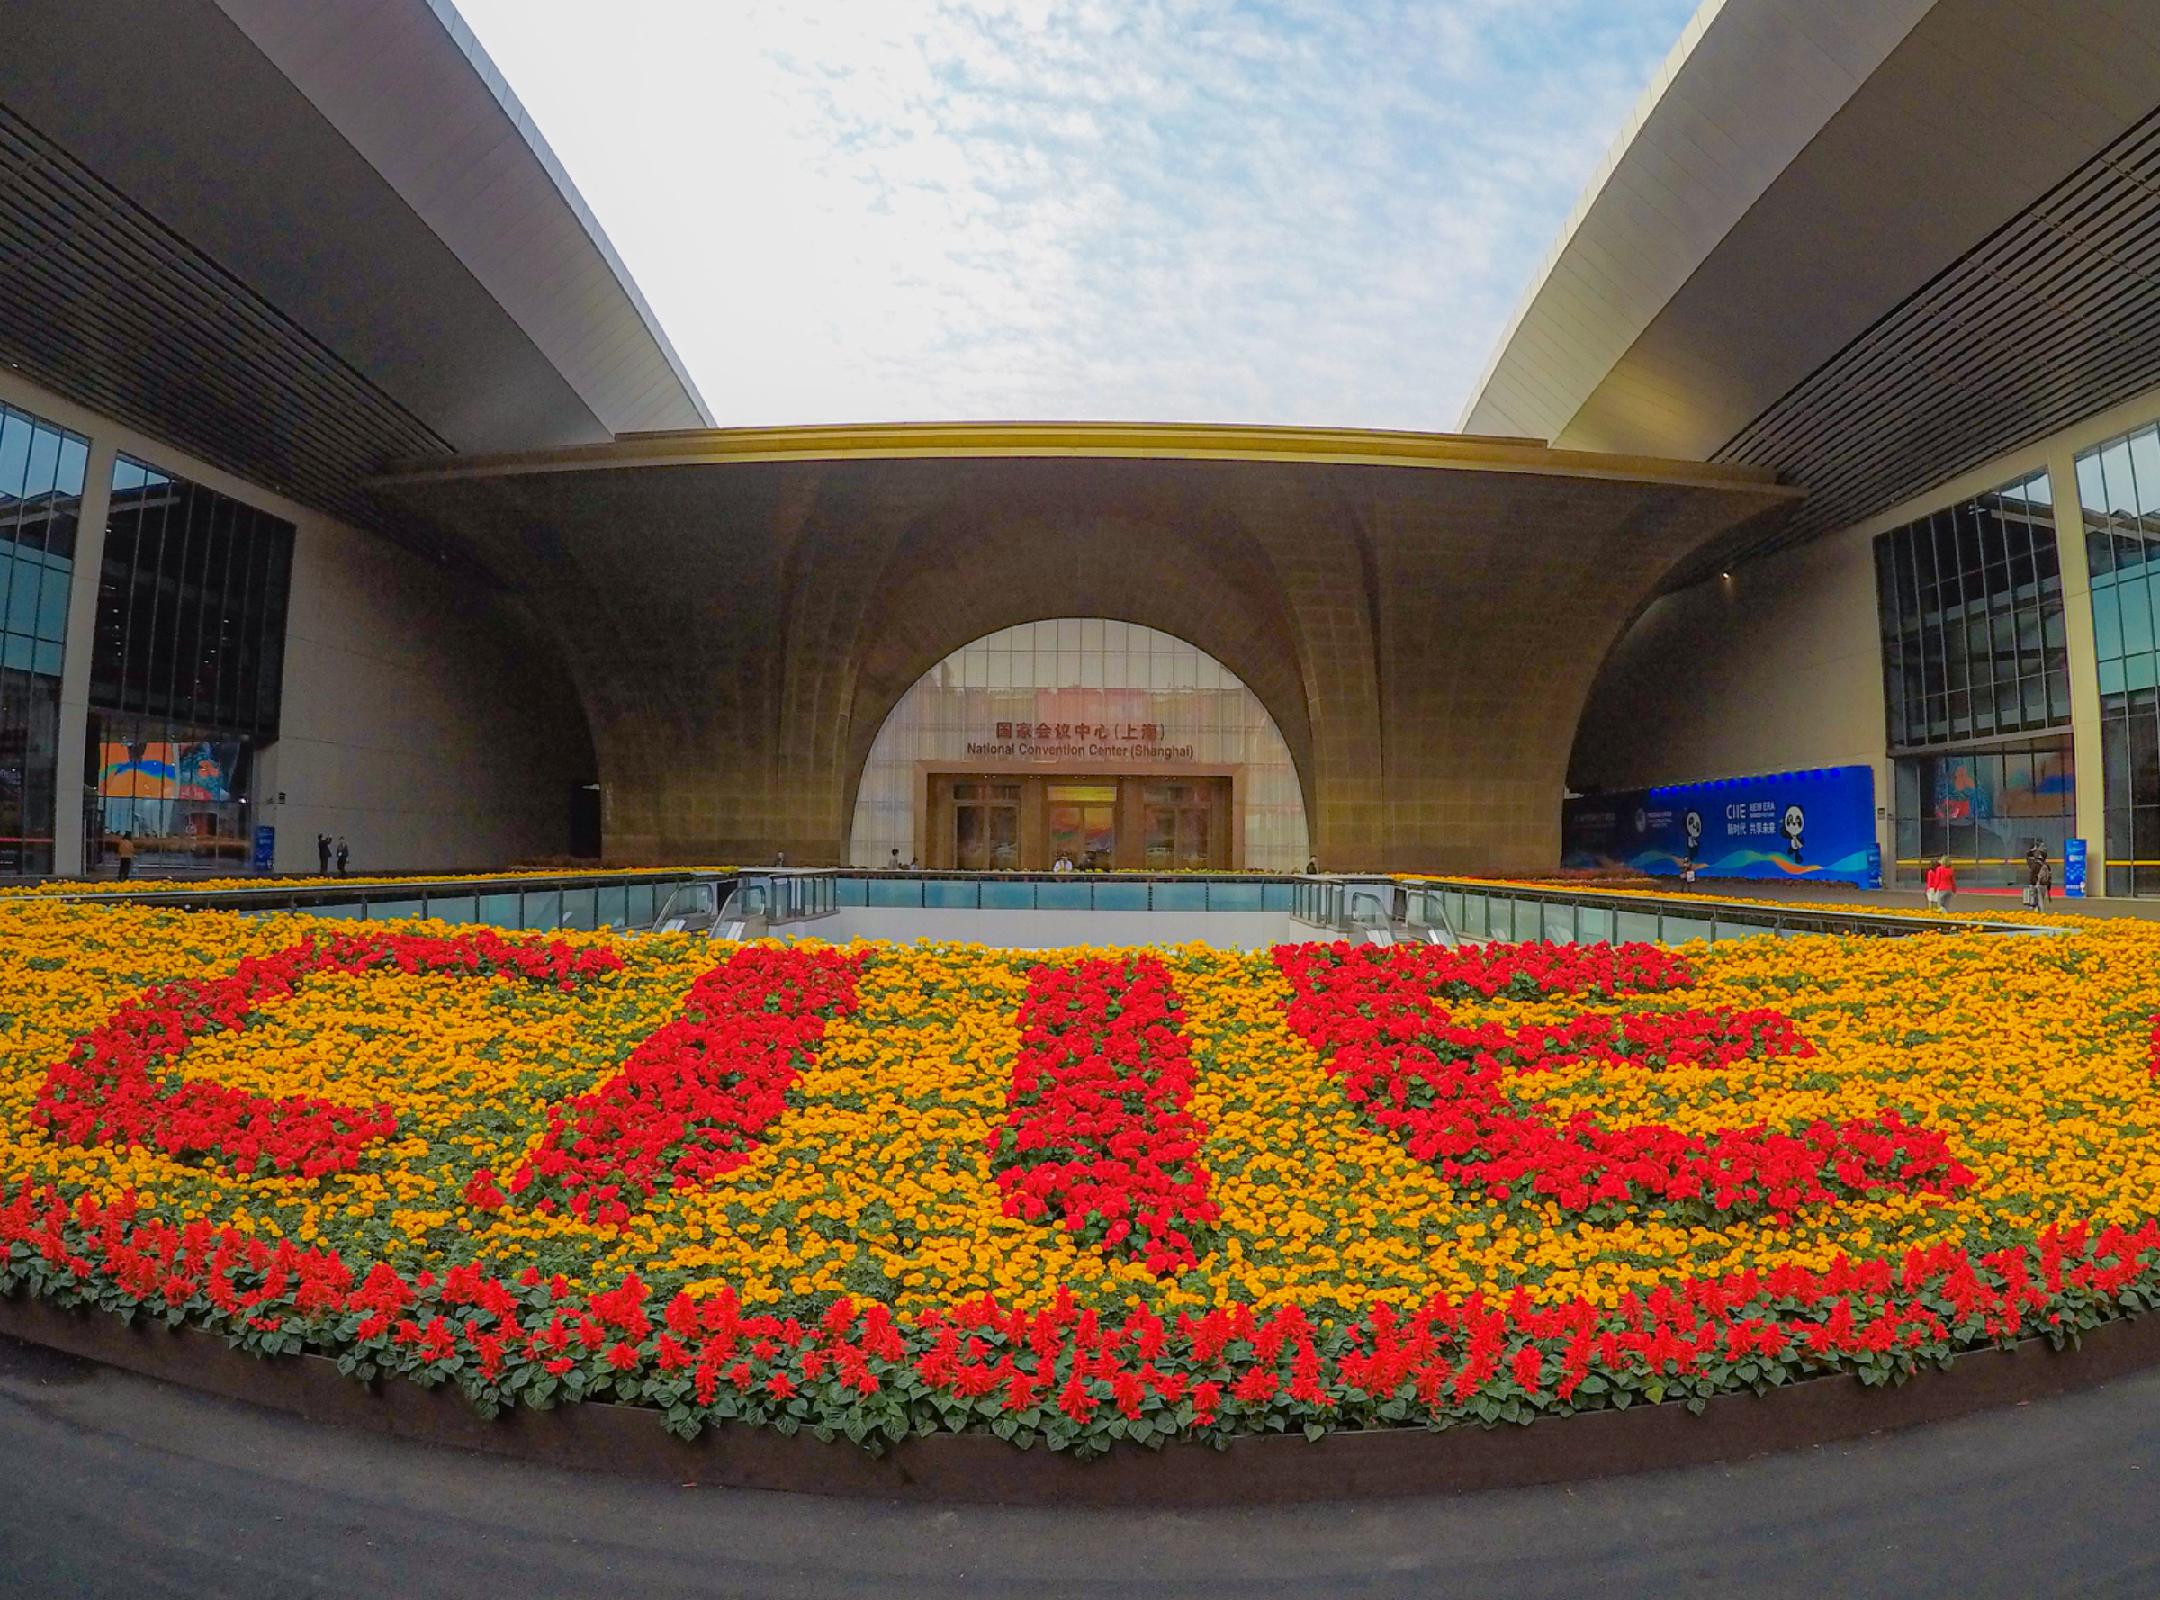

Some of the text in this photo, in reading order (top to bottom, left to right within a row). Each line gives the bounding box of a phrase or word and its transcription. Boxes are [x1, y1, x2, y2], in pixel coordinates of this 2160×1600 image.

[966, 742, 1194, 761] National Convention Center (Shanghai)
[1726, 804, 1746, 819] CIIE
[31, 930, 1976, 1272] CIIE
